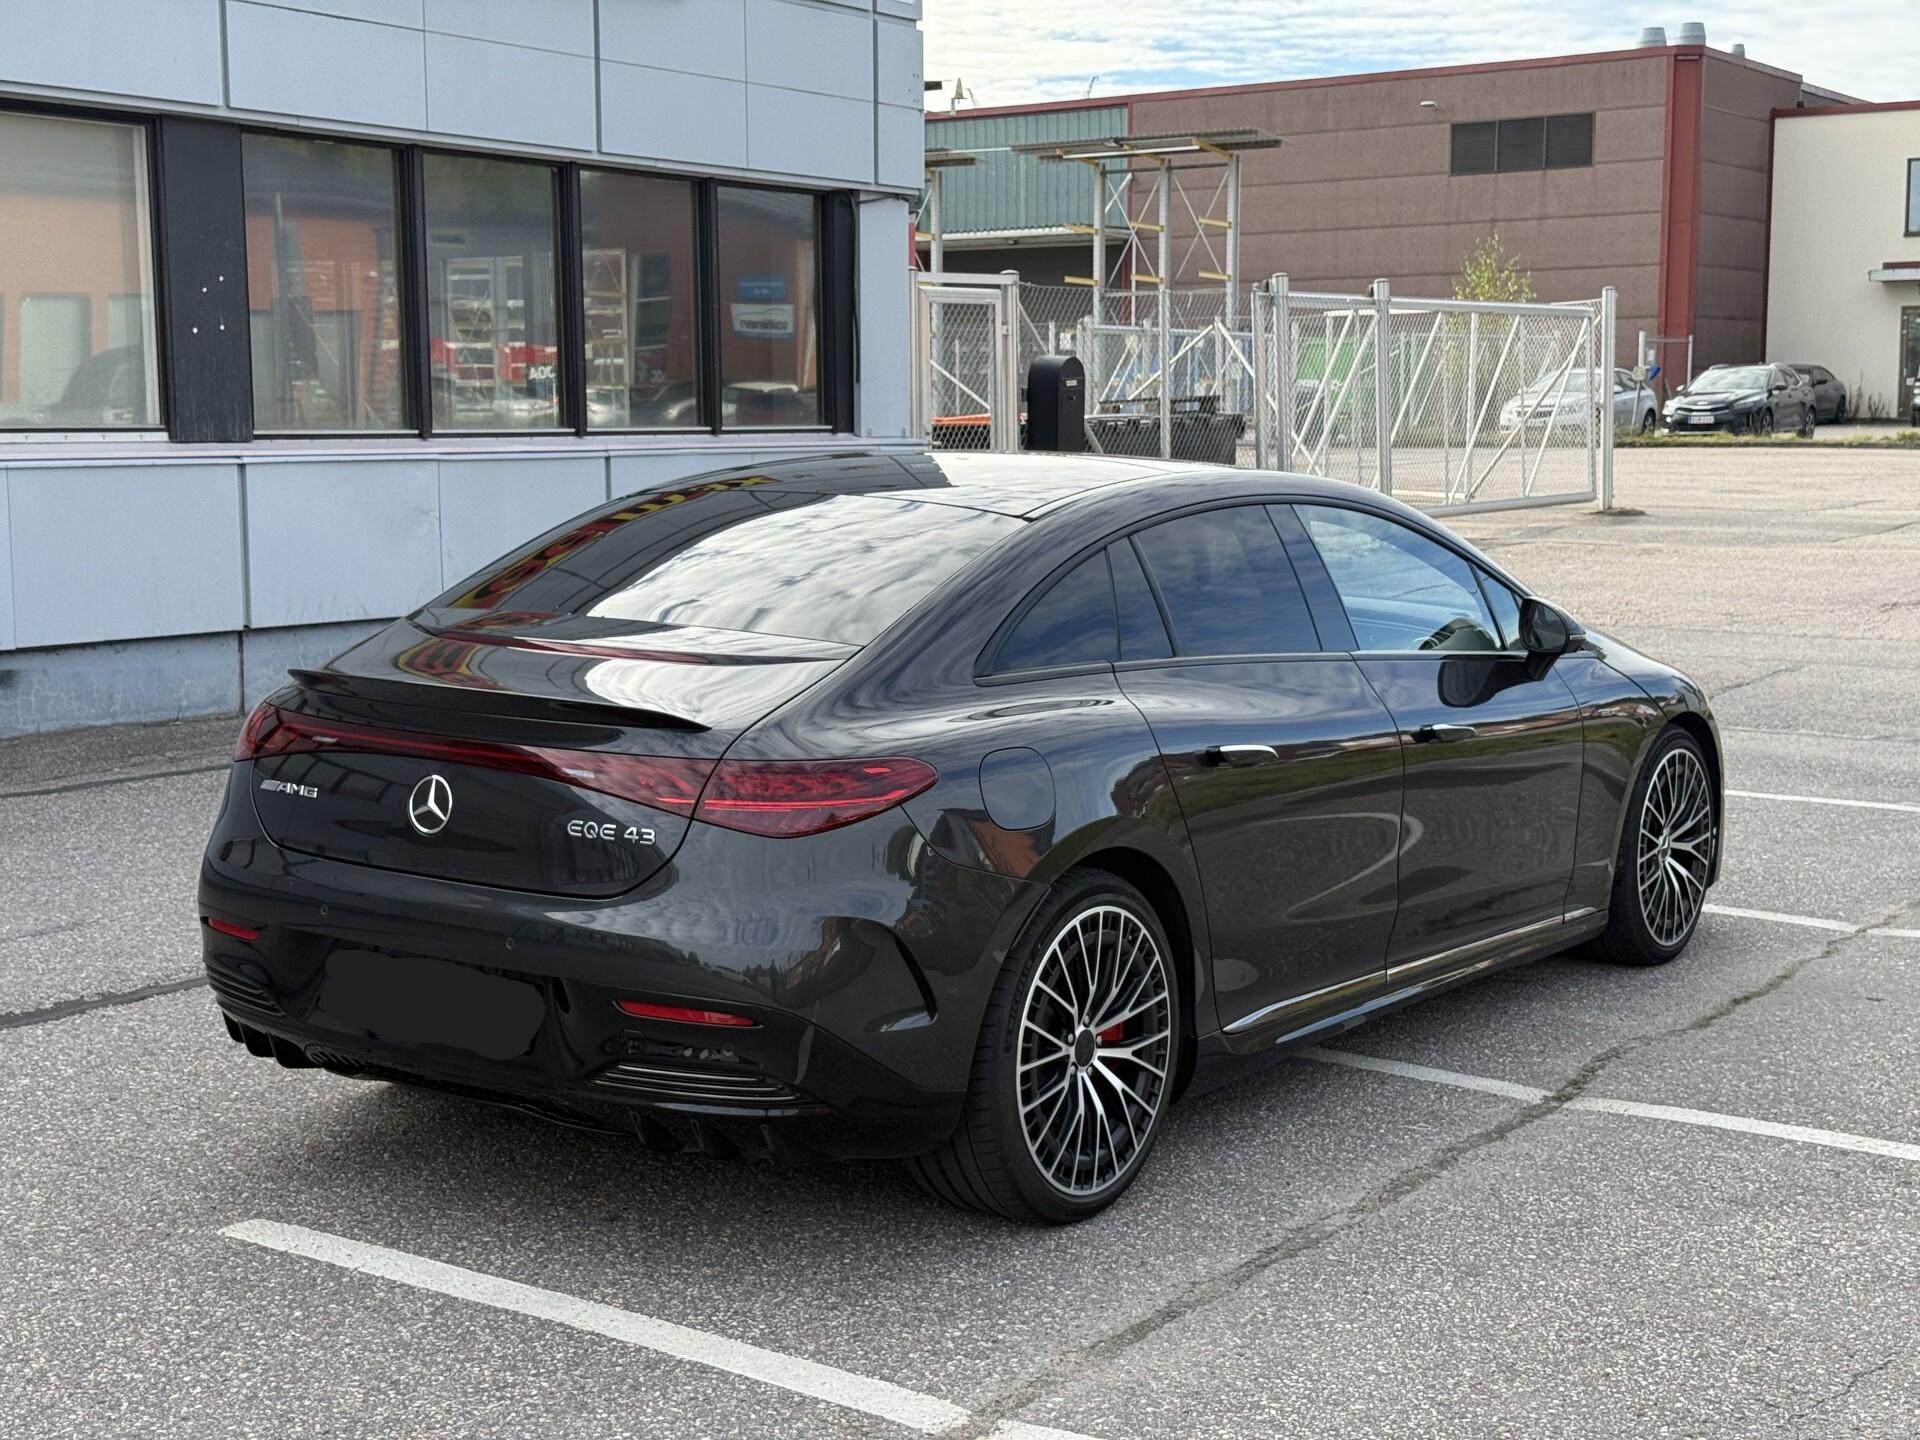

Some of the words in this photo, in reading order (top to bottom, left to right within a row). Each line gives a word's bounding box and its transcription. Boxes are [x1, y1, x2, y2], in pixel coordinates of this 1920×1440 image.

[275, 782, 319, 799] AMG
[567, 820, 617, 840] EQE
[623, 826, 656, 845] 43
